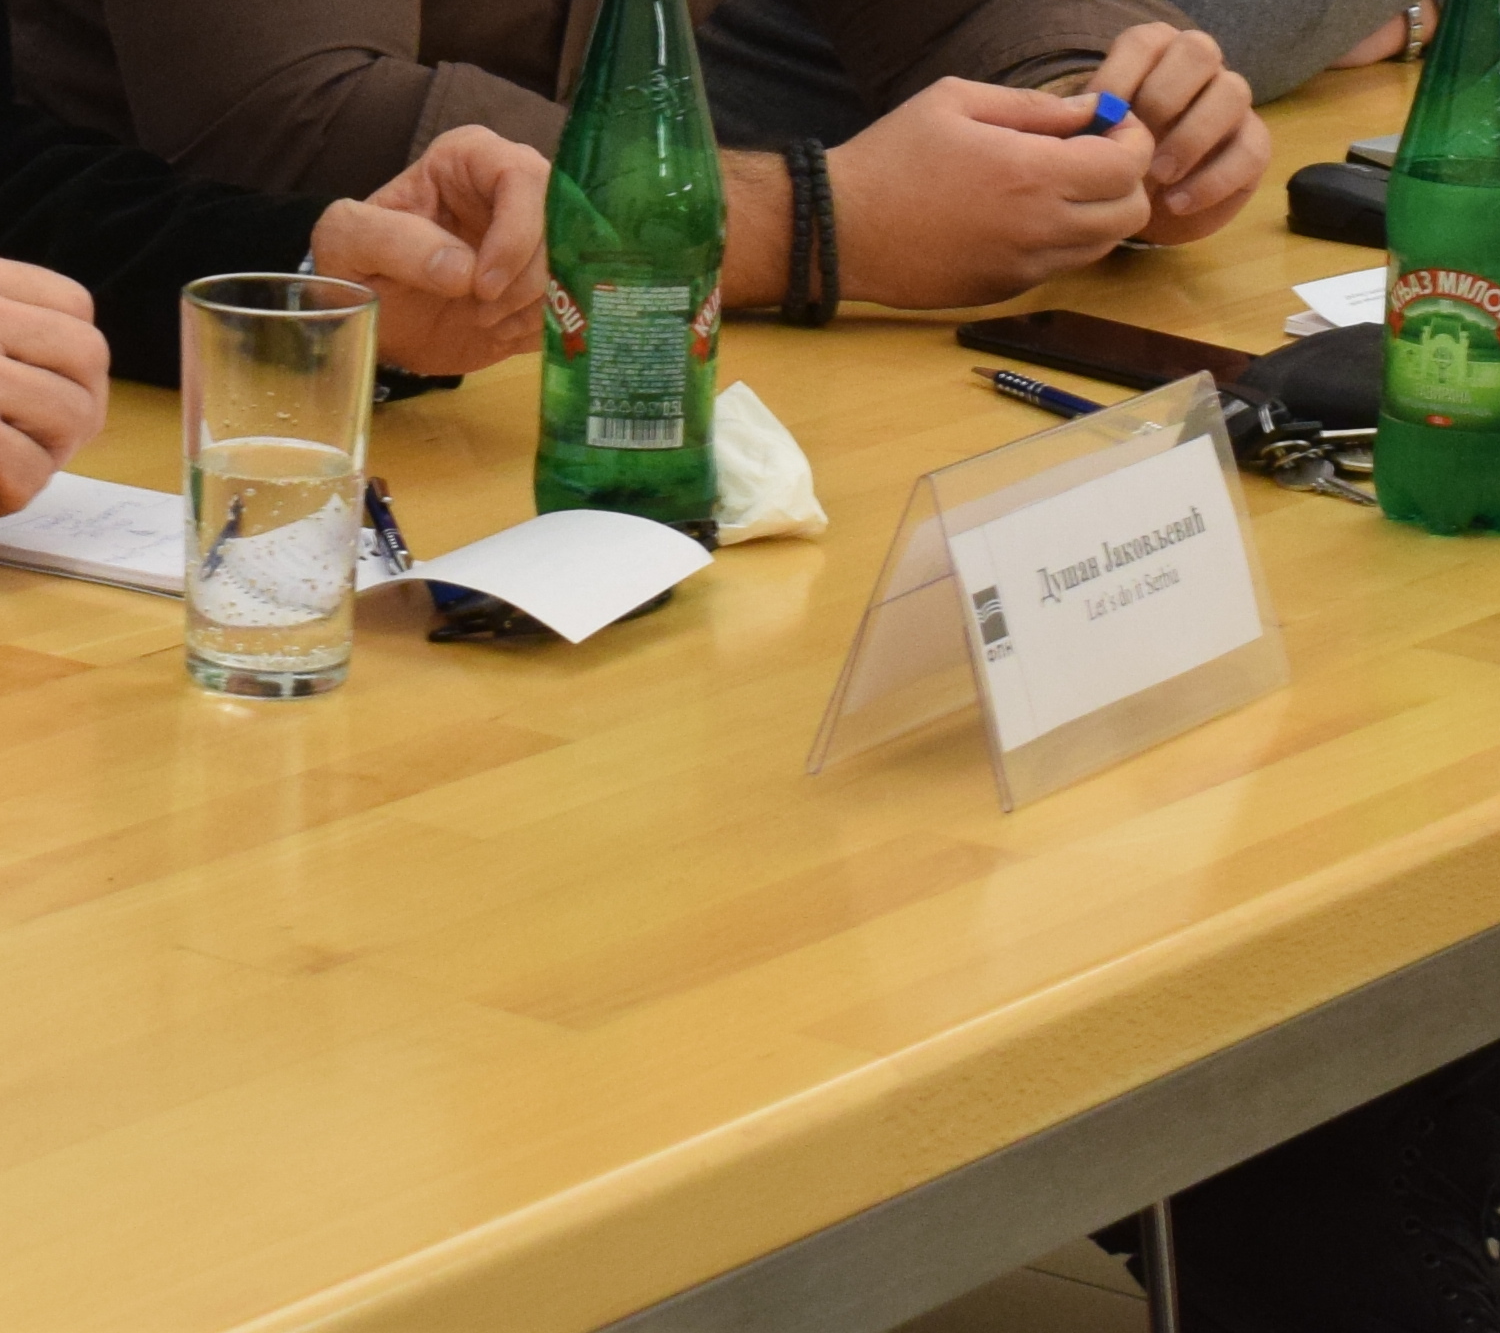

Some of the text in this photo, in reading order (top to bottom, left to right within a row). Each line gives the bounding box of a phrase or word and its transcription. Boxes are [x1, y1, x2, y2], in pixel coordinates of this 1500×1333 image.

[1390, 271, 1433, 312] КЊАЗ
[1036, 505, 1206, 604] Душан Јаковљевић
[1144, 565, 1181, 594] Serbia
